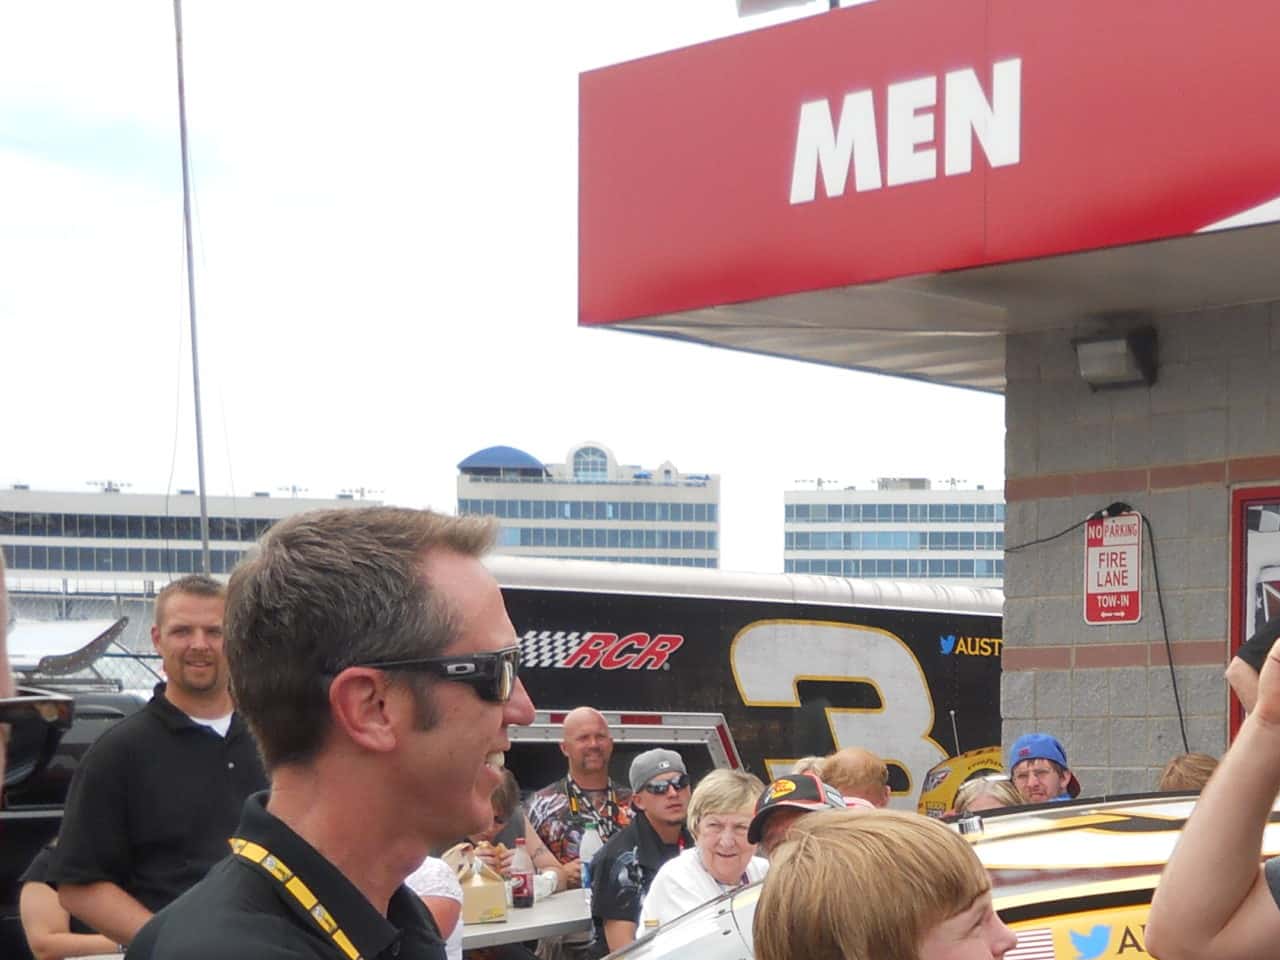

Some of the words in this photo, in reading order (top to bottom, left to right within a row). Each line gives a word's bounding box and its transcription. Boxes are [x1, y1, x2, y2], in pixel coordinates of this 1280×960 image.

[789, 57, 1022, 206] MEN
[1088, 525, 1103, 539] NO
[1104, 523, 1138, 537] PARKING
[1098, 551, 1127, 568] FIRE
[1097, 570, 1129, 587] LANE
[1097, 594, 1129, 608] TOW-IN
[564, 632, 684, 670] RCR
[1117, 924, 1147, 954] A
